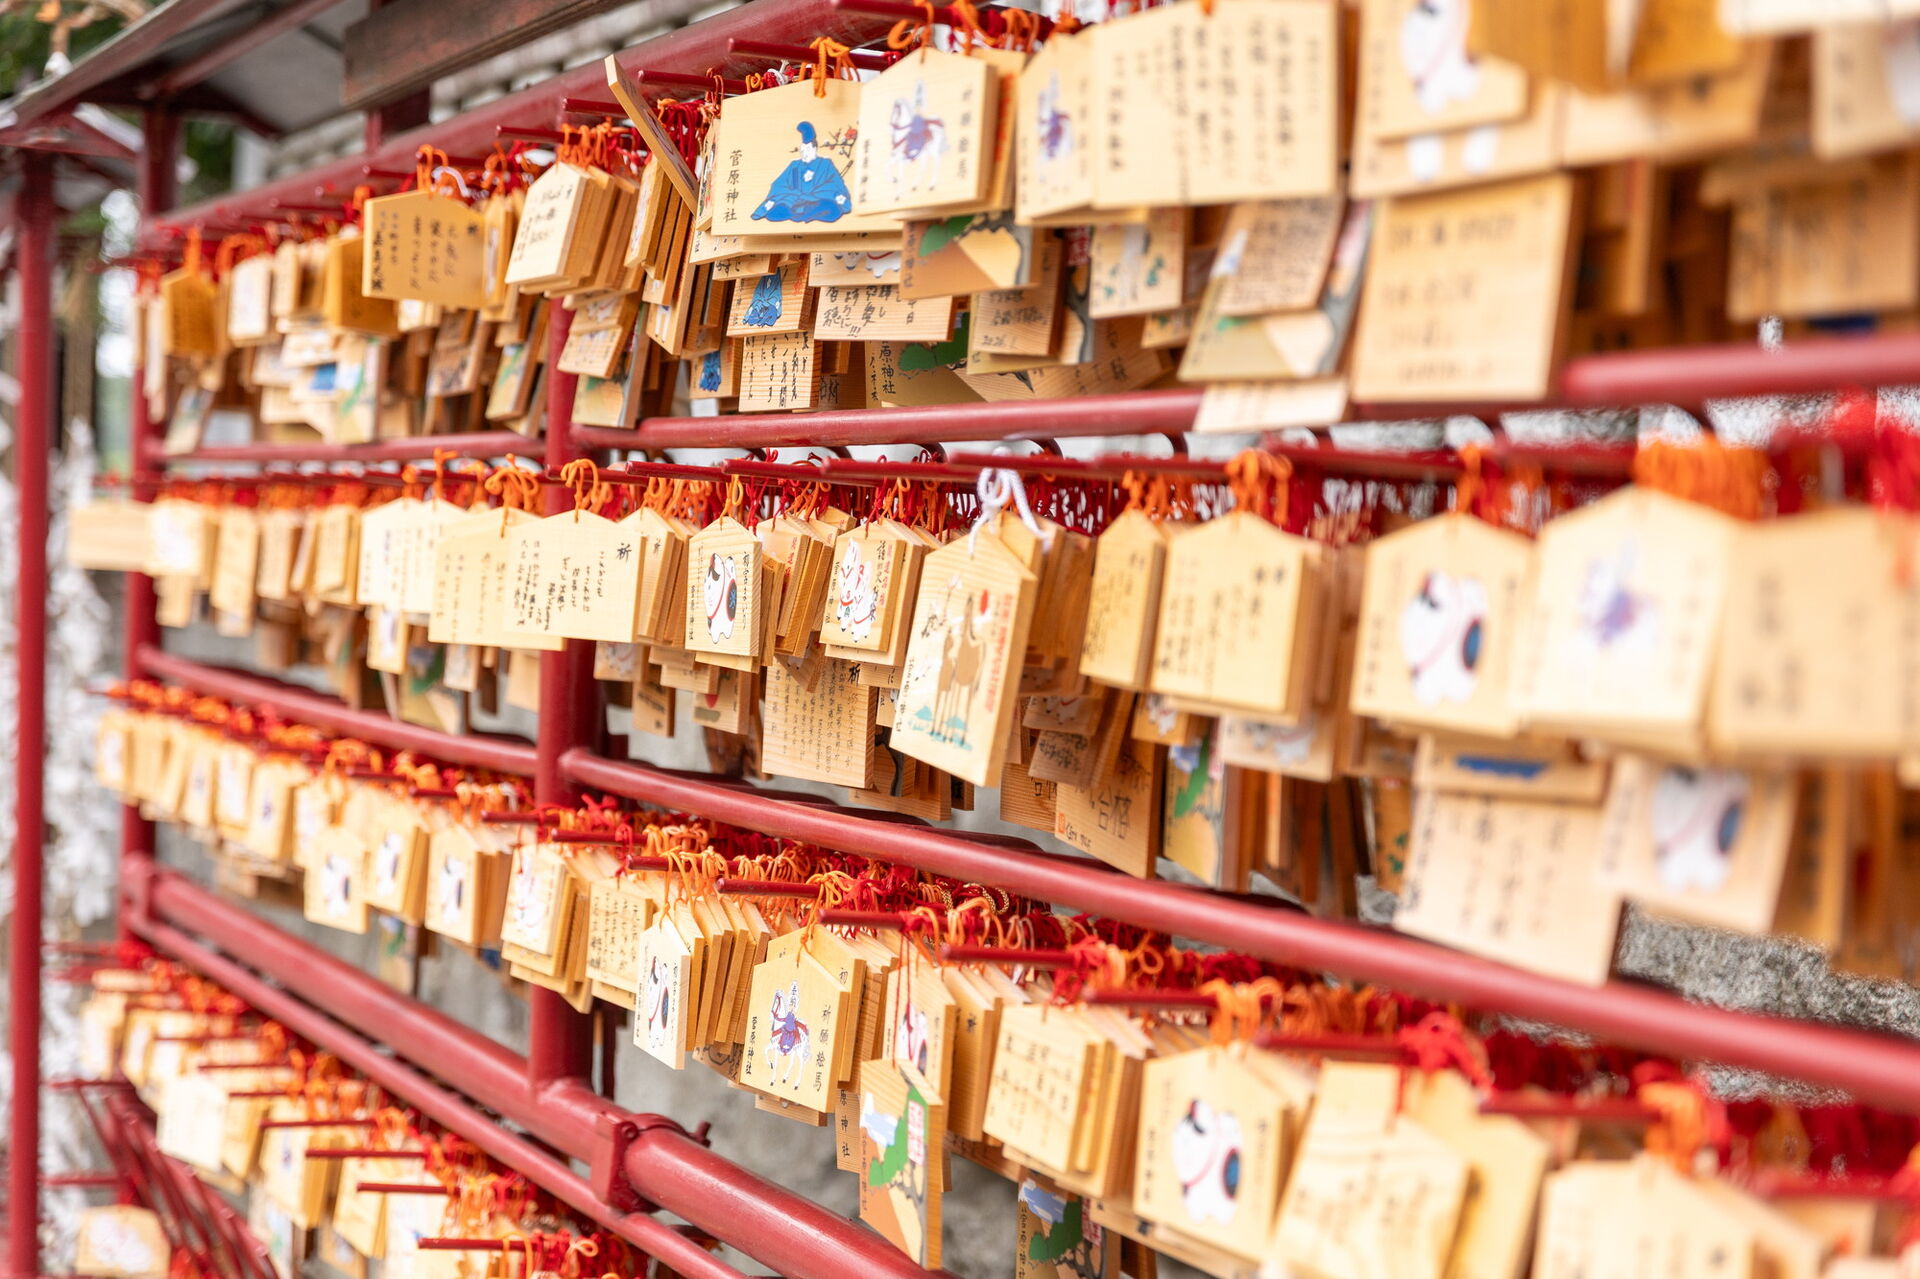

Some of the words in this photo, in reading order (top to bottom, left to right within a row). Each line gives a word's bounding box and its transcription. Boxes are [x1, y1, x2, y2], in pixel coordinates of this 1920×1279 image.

[723, 150, 743, 223] 菅原神社
[879, 341, 896, 394] 原神社
[616, 542, 632, 562] 祈
[745, 1016, 758, 1076] 菅原神社
[813, 1004, 832, 1092] 祈願絵馬
